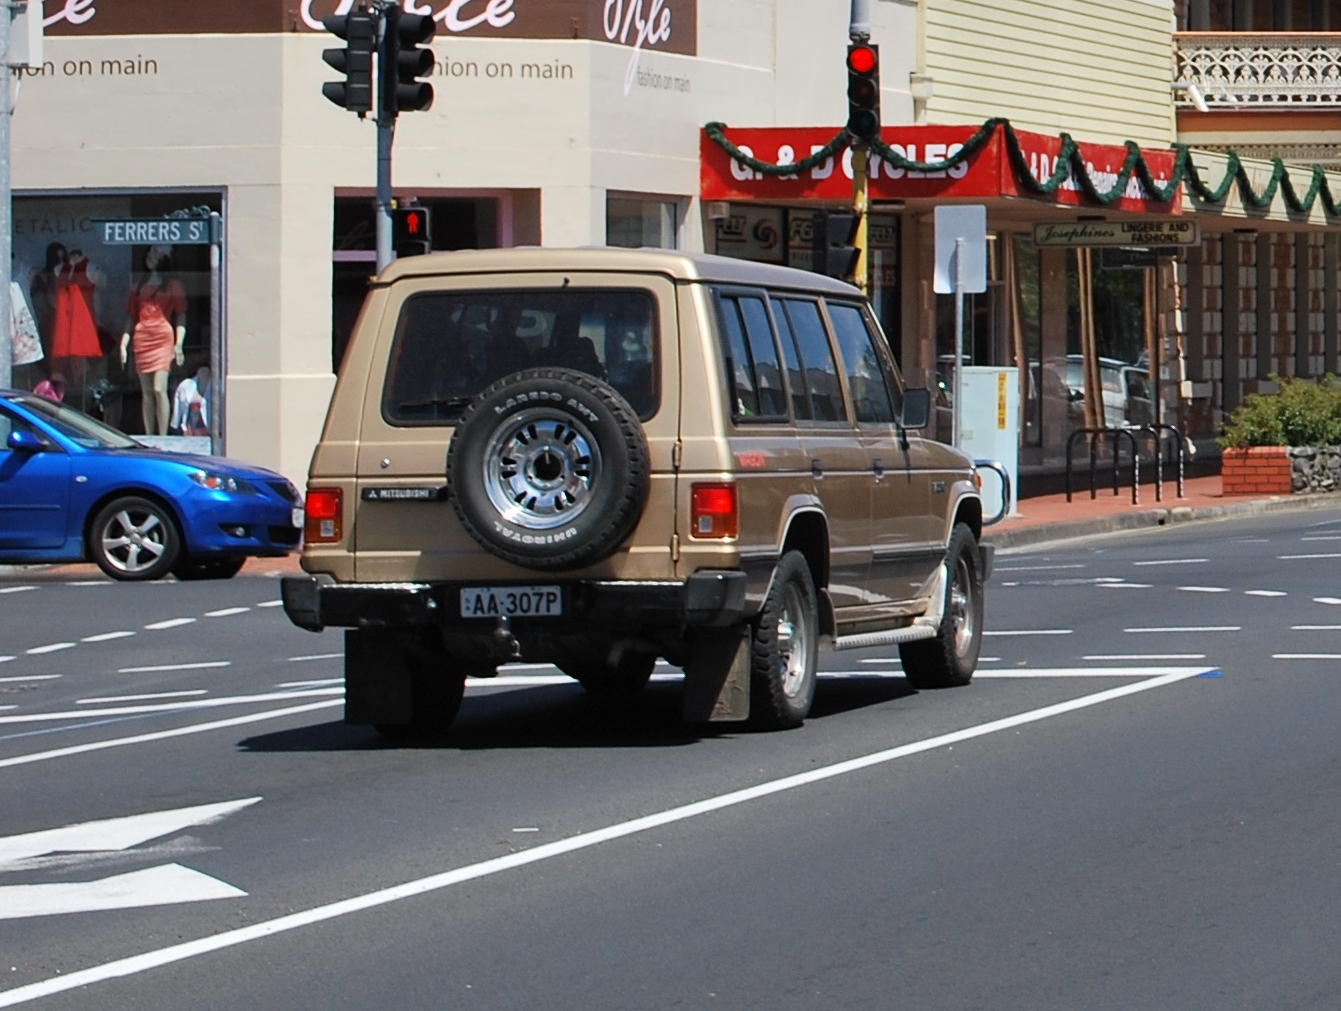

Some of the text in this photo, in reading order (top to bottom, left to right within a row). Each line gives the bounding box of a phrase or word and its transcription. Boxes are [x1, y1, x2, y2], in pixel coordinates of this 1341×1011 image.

[63, 59, 92, 76] on
[101, 54, 157, 76] main
[485, 61, 513, 78] on
[521, 58, 573, 79] main
[674, 74, 691, 93] main
[777, 145, 799, 180] &
[811, 145, 834, 179] D
[15, 217, 92, 235] ETALIC
[104, 221, 181, 241] FERRERS
[1039, 222, 1189, 242] Josephines LINGERIE AND
[1131, 232, 1179, 243] FASHIONS
[494, 391, 563, 415] LAREDO
[380, 489, 430, 499] MITSUBISHI
[493, 520, 578, 545] UNIROYAL
